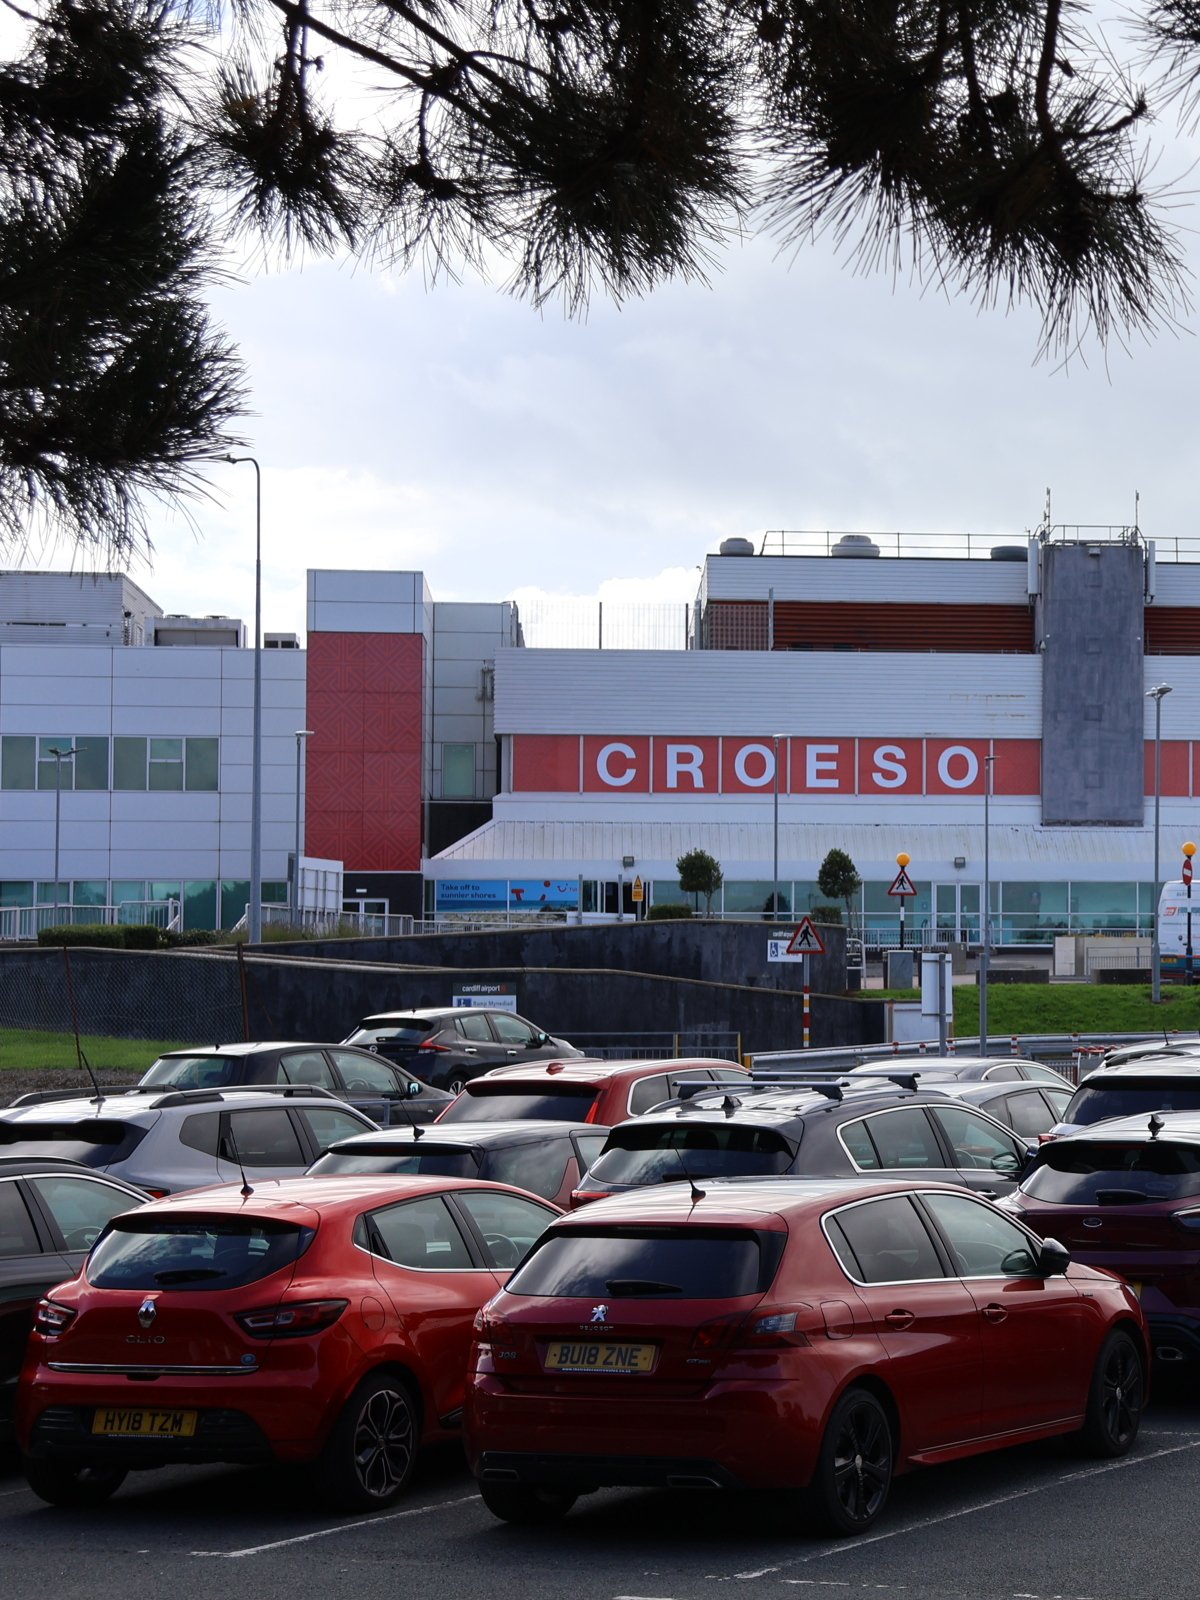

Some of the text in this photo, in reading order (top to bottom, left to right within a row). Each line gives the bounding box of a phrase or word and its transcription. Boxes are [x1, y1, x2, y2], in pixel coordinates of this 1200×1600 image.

[596, 742, 979, 789] CROESO
[440, 883, 459, 891] Take
[460, 883, 471, 891] off
[461, 984, 500, 994] cardiff airport
[557, 1345, 642, 1367] BU18 ZNE
[103, 1411, 185, 1433] HY18 TZM
